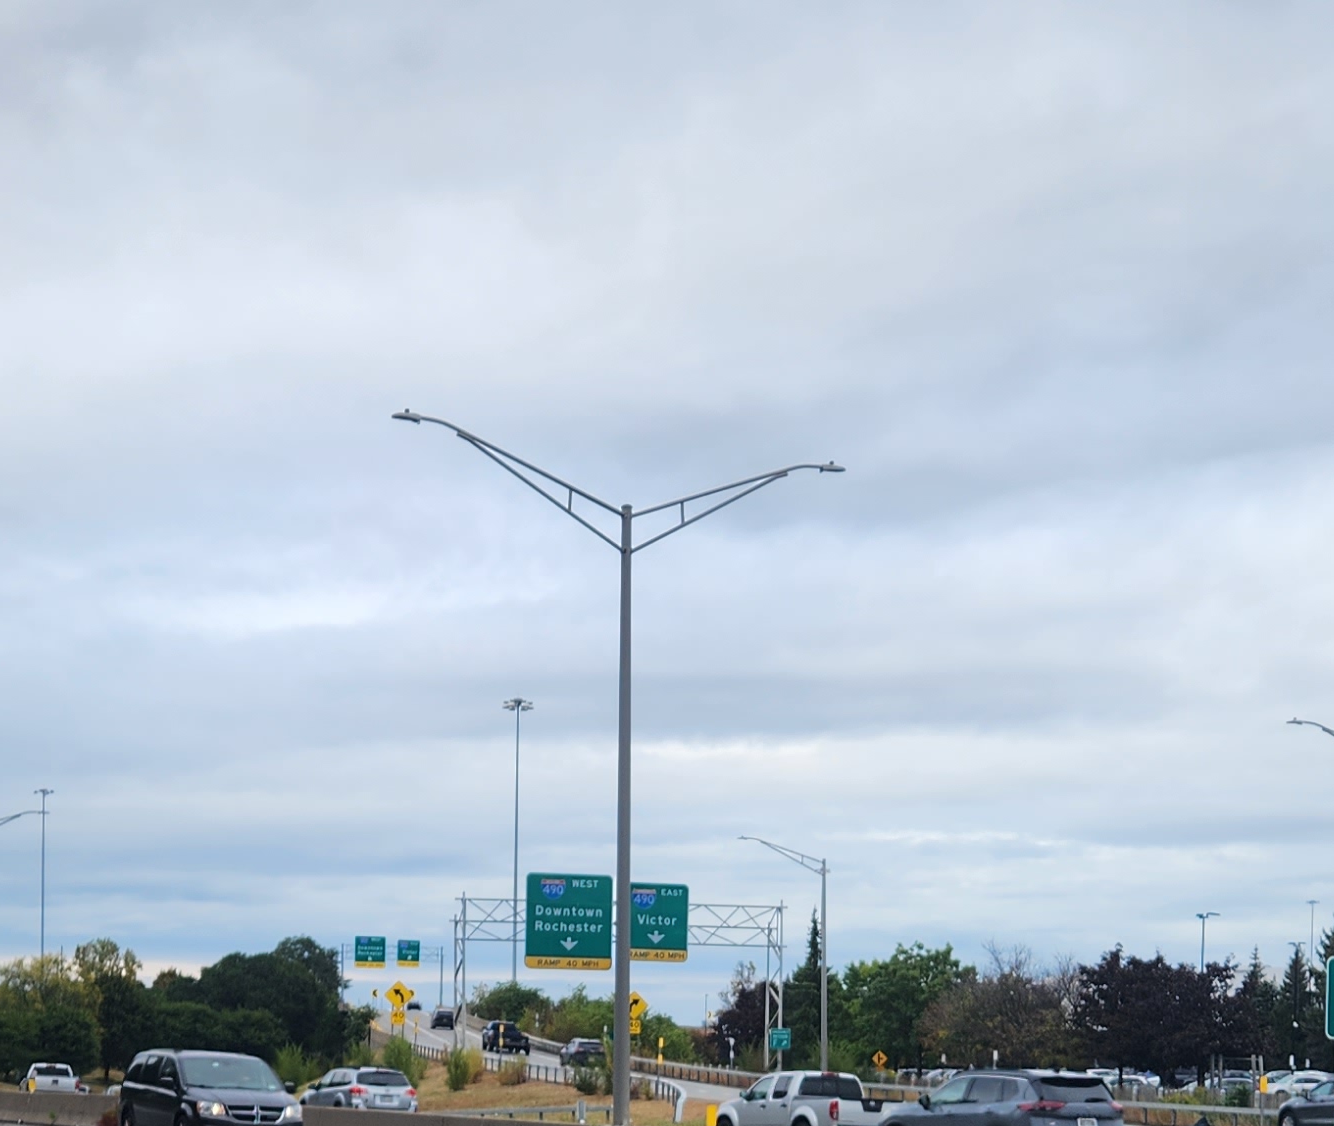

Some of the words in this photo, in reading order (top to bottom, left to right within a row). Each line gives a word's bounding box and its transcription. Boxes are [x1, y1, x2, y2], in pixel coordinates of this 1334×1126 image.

[542, 884, 564, 895] 490
[572, 879, 599, 888] WEST
[634, 894, 655, 905] 490
[661, 888, 683, 896] EAST
[535, 904, 603, 917] Downtown
[637, 913, 677, 926] Victor
[534, 920, 604, 933] Rochester
[654, 951, 665, 959] 40
[537, 959, 561, 967] RAMP
[581, 960, 599, 968] MPH
